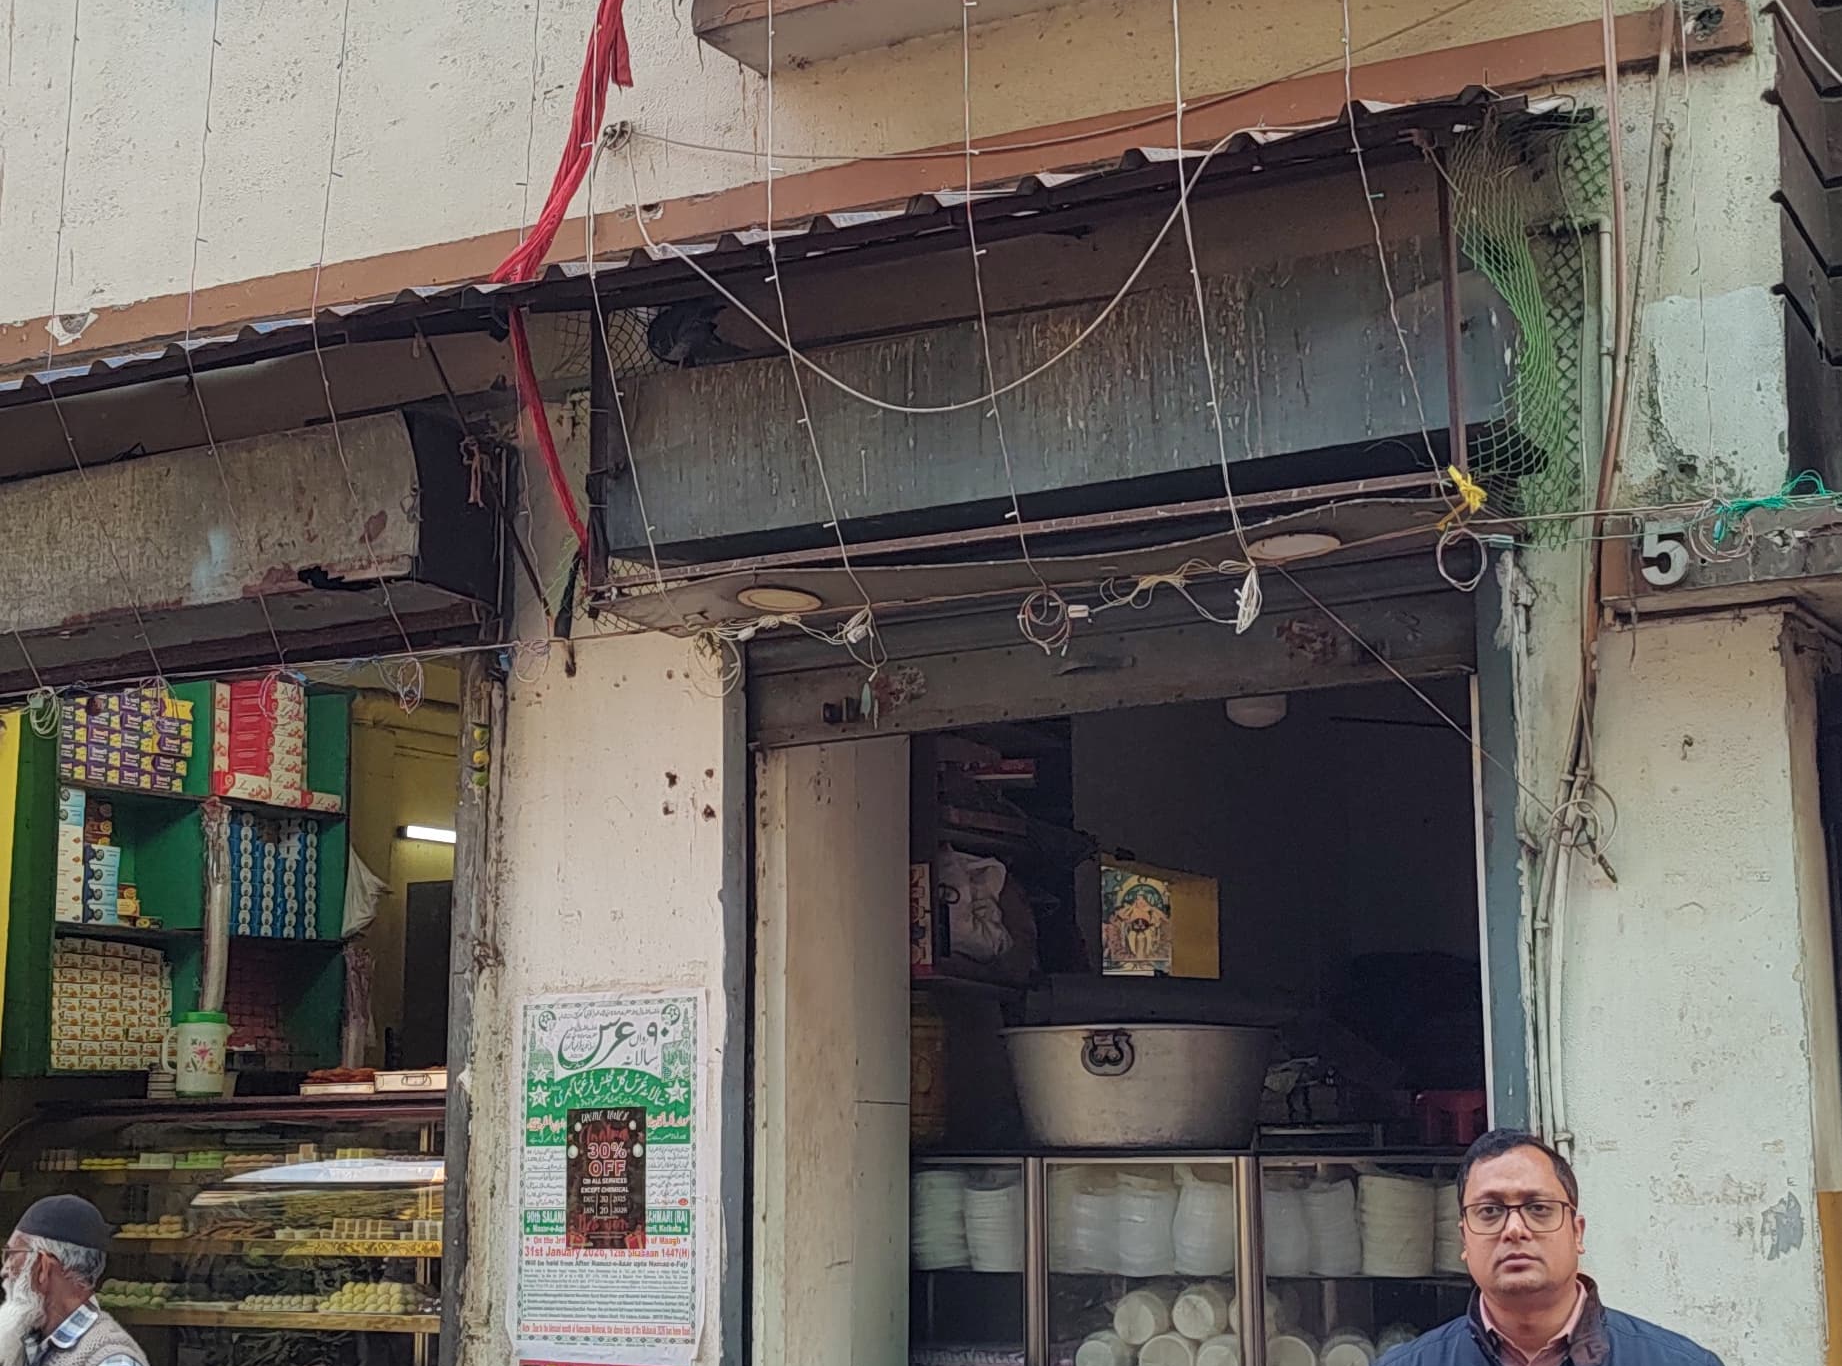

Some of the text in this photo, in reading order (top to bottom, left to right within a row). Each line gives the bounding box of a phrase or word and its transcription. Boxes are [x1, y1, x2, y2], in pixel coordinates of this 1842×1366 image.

[1640, 520, 1690, 587] 5
[587, 1141, 628, 1159] 30%
[588, 1160, 626, 1177] OFF
[525, 1245, 543, 1257] 31st
[546, 1245, 580, 1260] January
